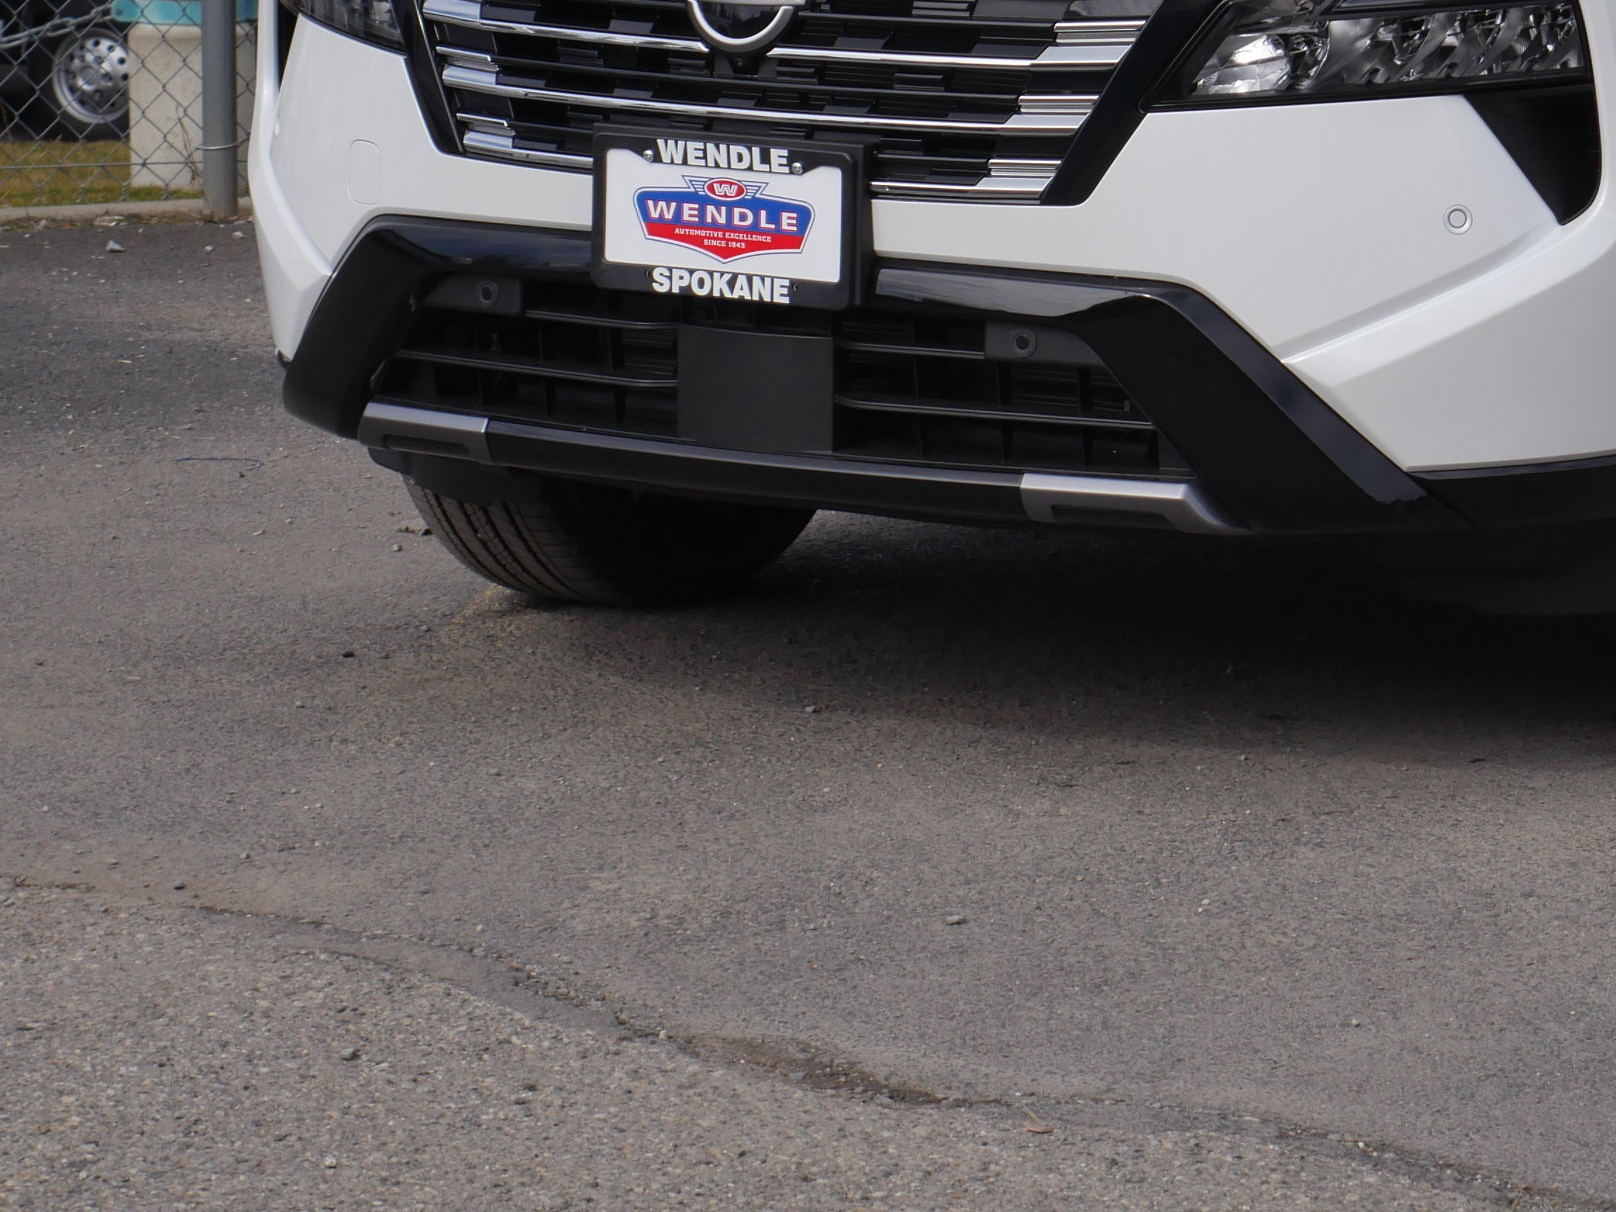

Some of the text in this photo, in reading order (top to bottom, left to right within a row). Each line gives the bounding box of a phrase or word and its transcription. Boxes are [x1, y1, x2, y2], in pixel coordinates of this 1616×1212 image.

[656, 138, 790, 174] WENDLE
[646, 199, 799, 232] WENDLE
[674, 227, 772, 243] AUTOMOTIVE EXCELLENCE
[703, 239, 746, 249] SINCE 1943
[652, 266, 790, 304] SPOKANE
